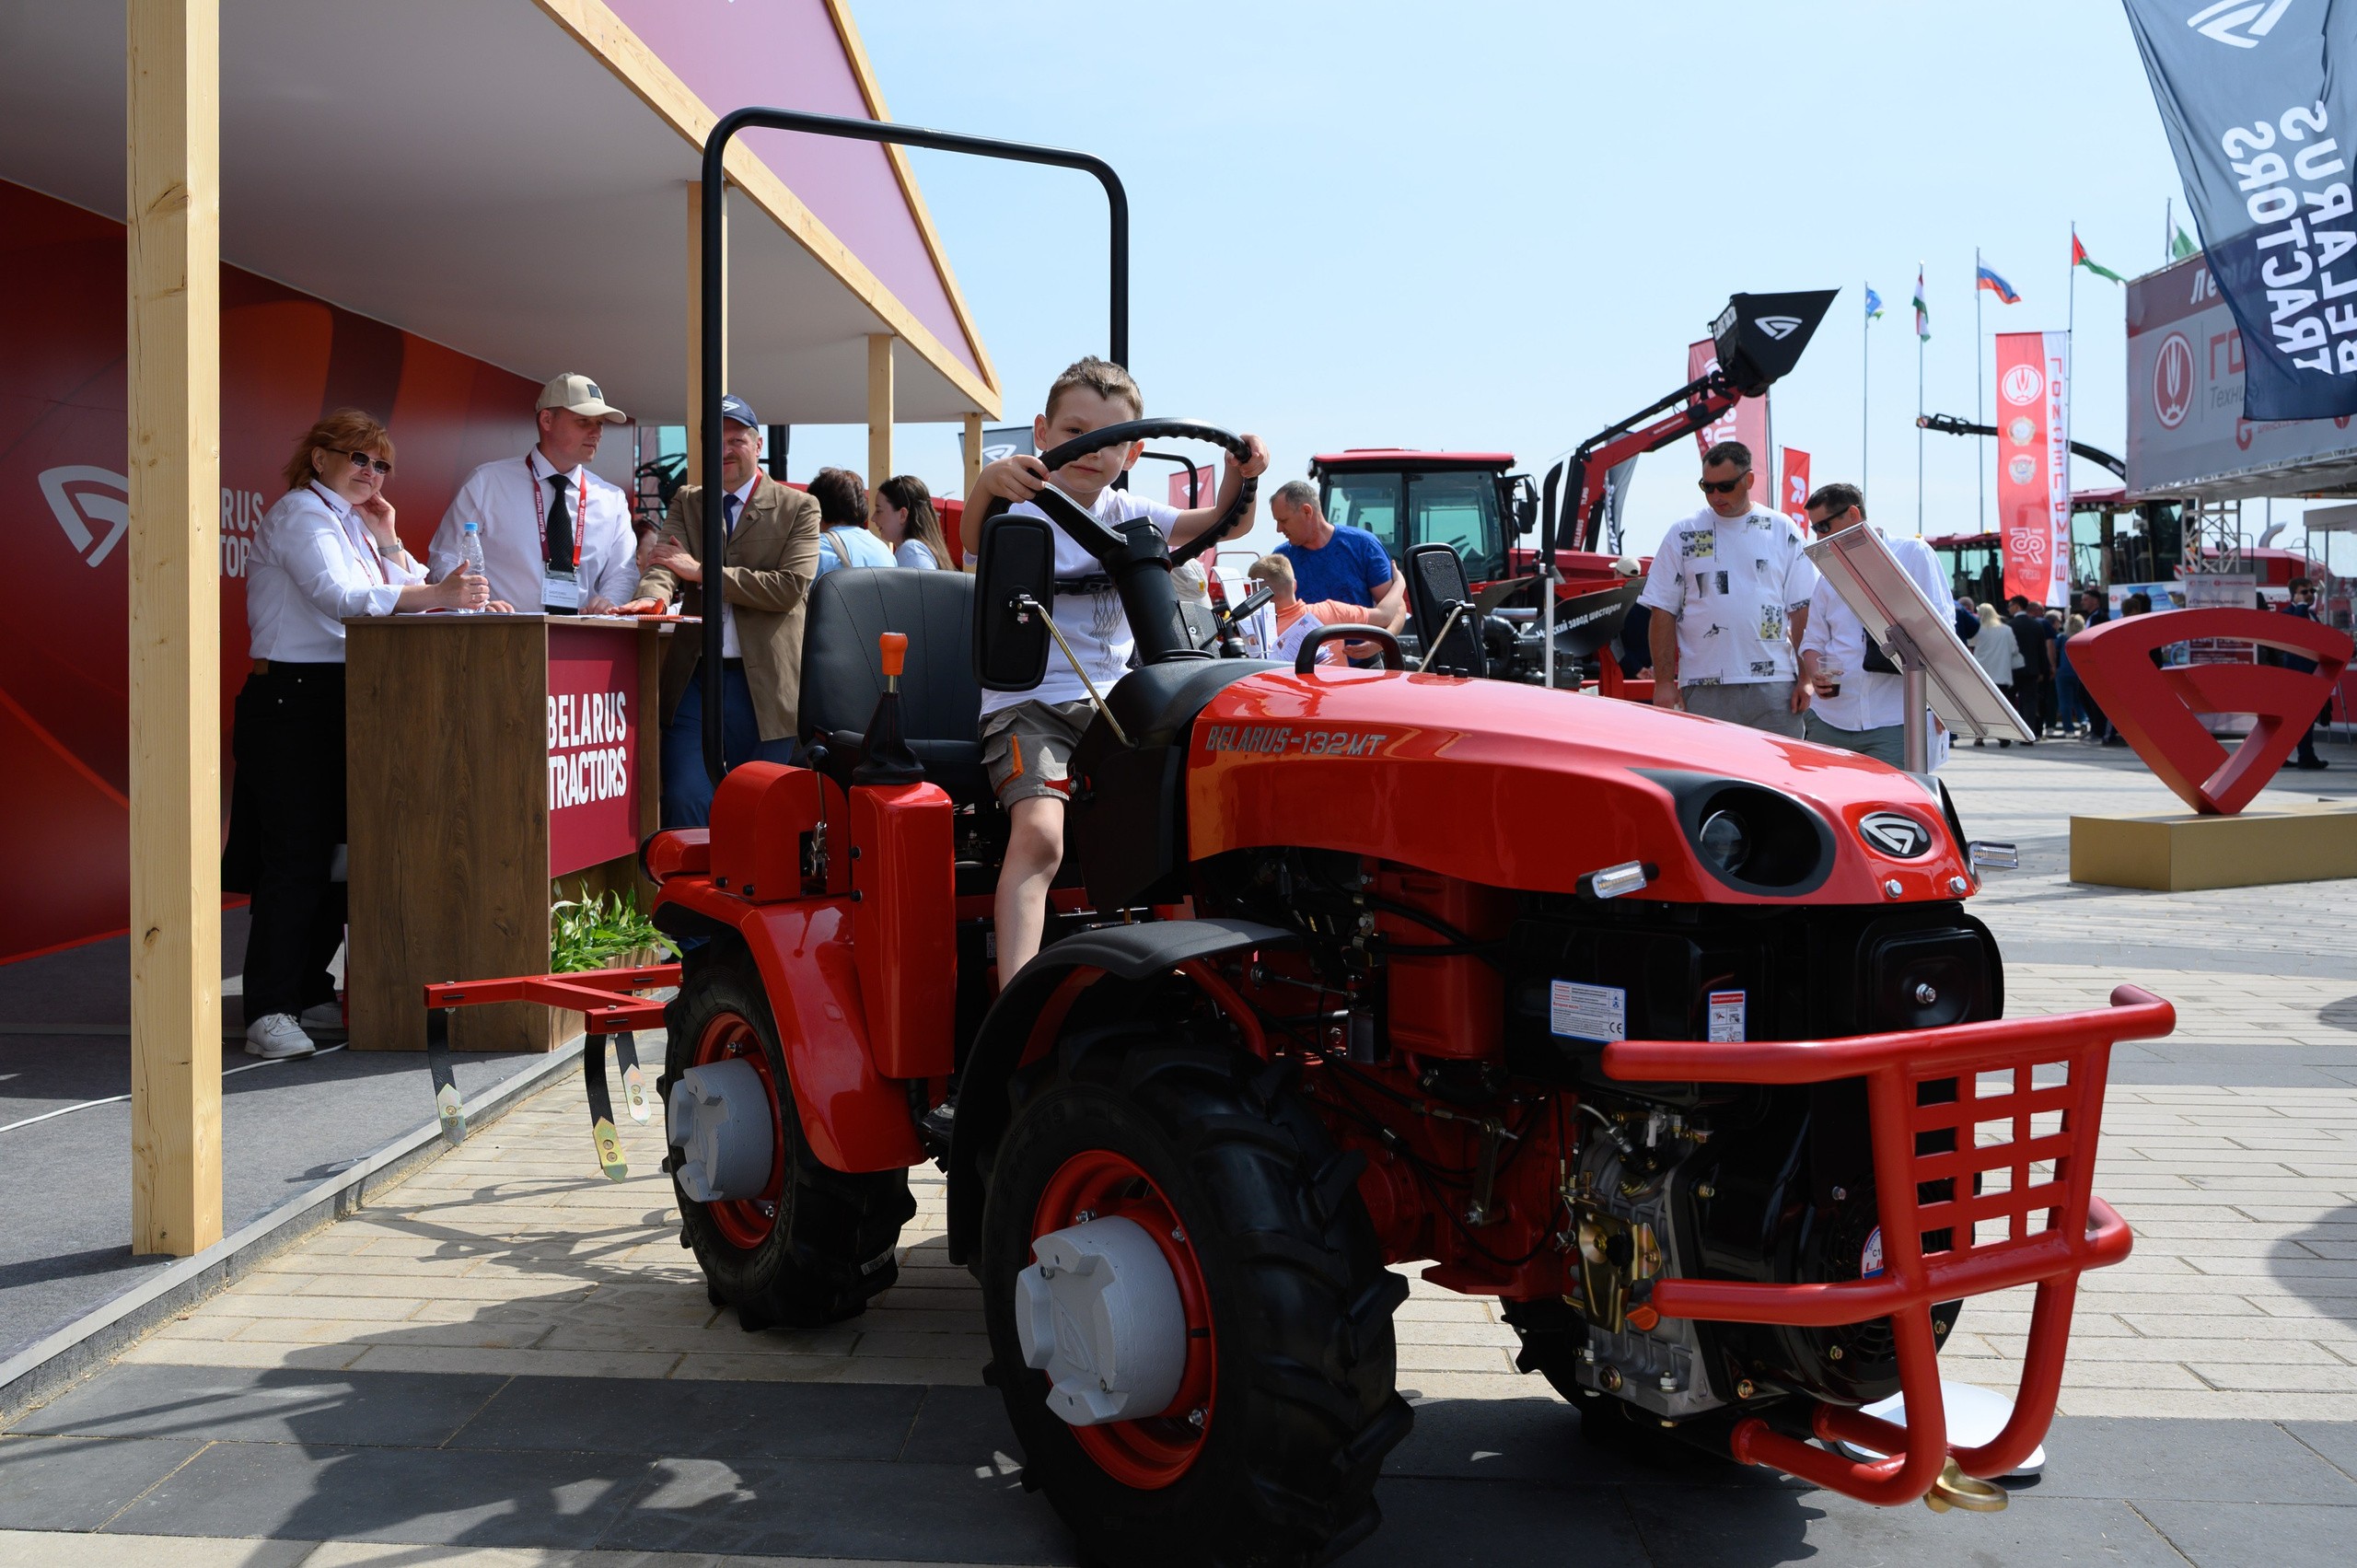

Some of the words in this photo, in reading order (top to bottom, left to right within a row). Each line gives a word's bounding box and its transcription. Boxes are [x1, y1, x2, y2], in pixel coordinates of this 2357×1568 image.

[1567, 614, 1589, 630] завод
[548, 691, 627, 749] BELARUS
[548, 746, 627, 810] TRACTORS
